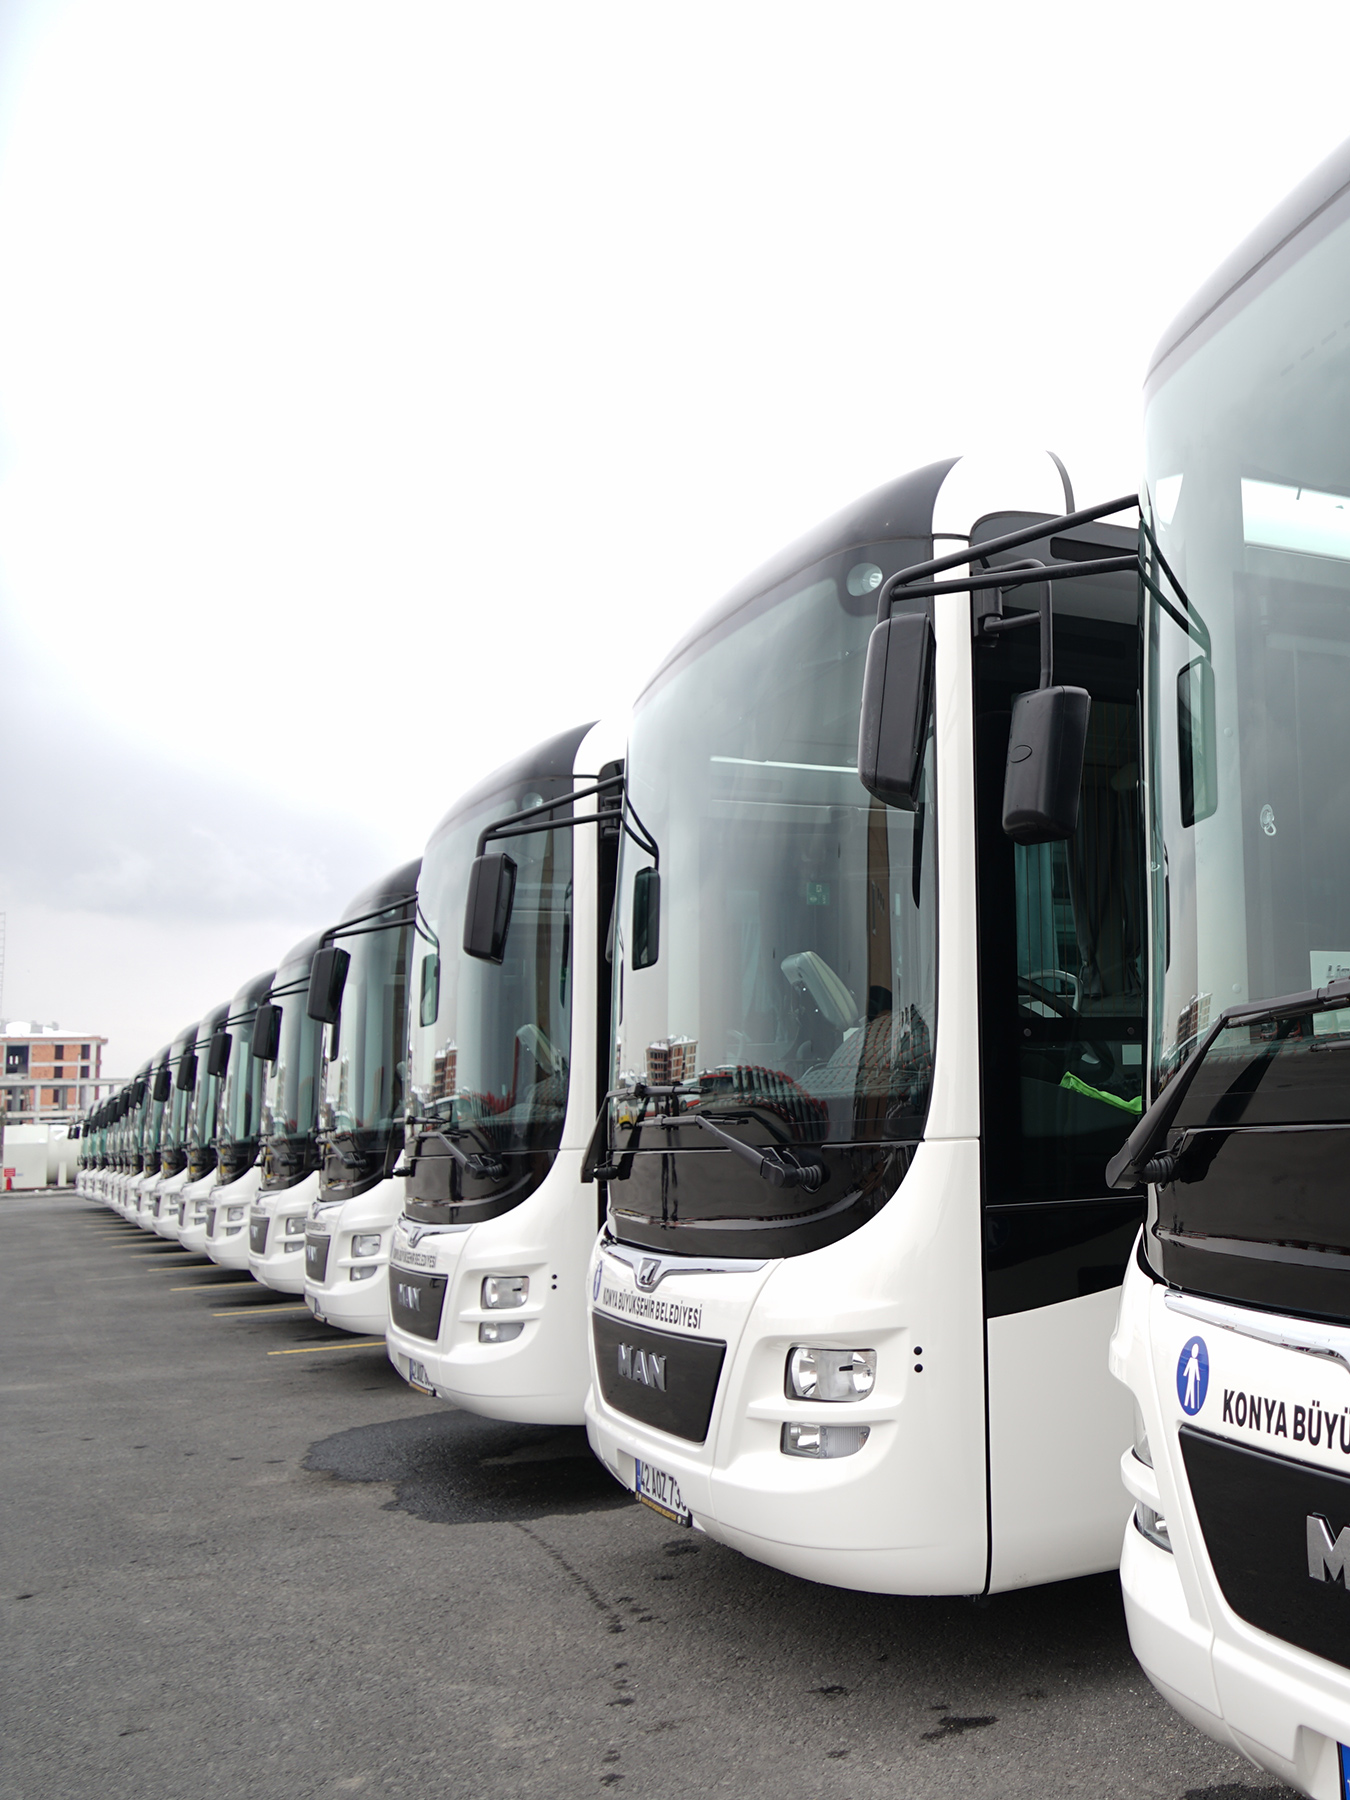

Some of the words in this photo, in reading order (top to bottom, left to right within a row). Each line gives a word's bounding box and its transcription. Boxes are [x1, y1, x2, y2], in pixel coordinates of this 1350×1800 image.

[655, 1300, 702, 1329] BELEDİYESİ
[618, 1342, 666, 1392] MAN
[1222, 1388, 1288, 1438] KONYA
